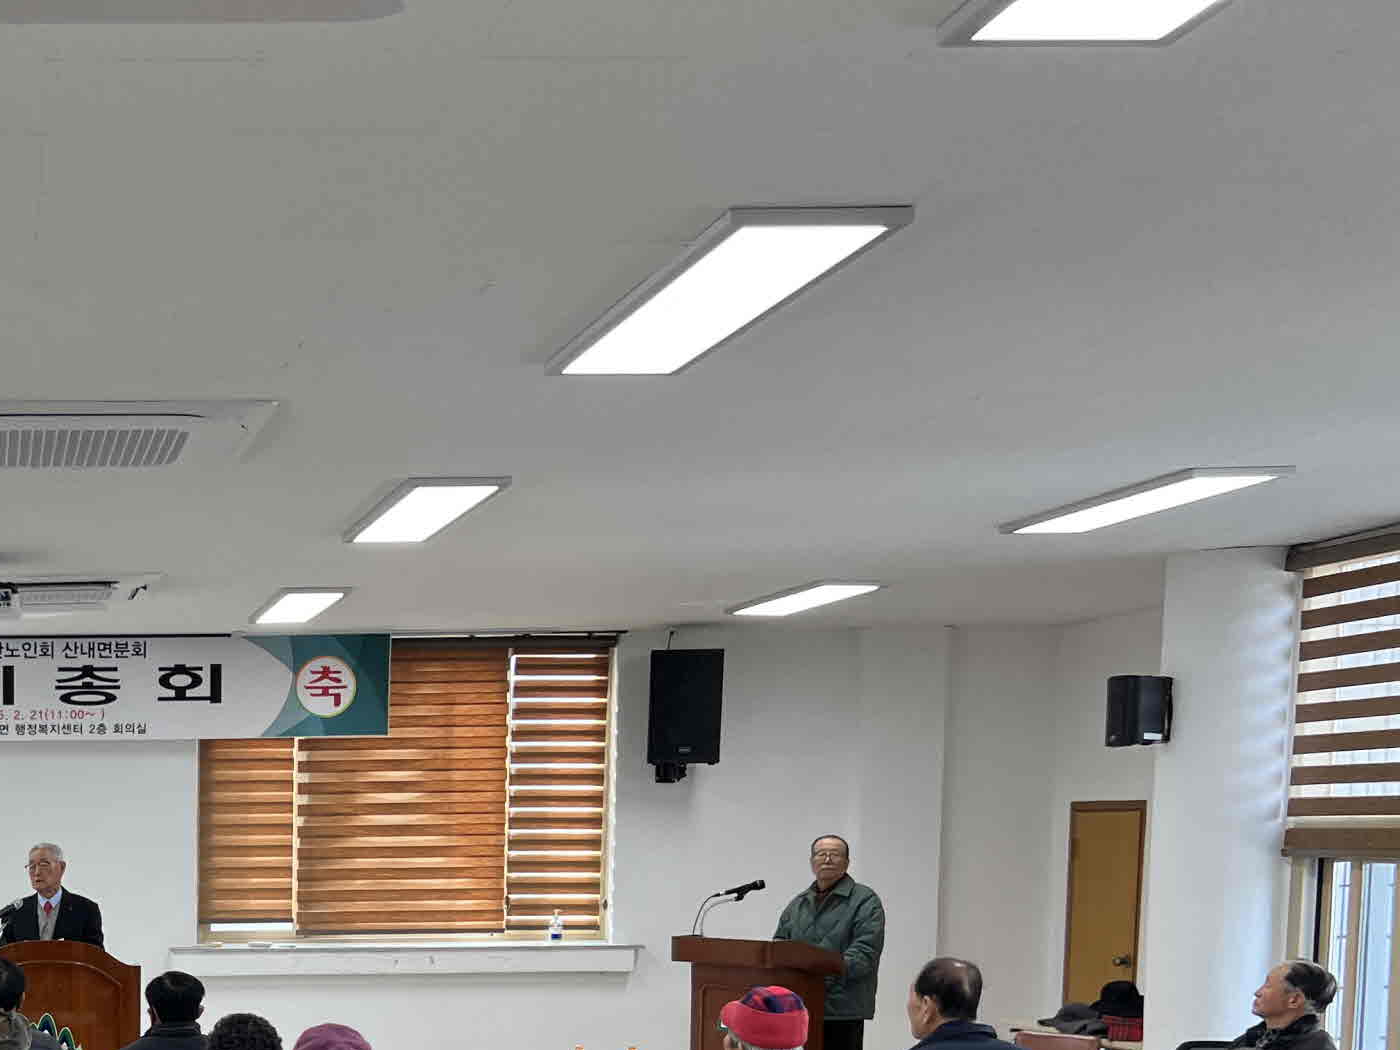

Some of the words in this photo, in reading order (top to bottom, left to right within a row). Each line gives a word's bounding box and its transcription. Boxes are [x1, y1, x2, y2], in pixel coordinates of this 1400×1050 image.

[62, 639, 147, 659] 산내면분회
[304, 664, 348, 708] 축
[13, 708, 25, 721] 2.
[14, 723, 83, 736] 행정복지센터
[88, 723, 108, 736] 2층
[112, 722, 147, 736] 회의실
